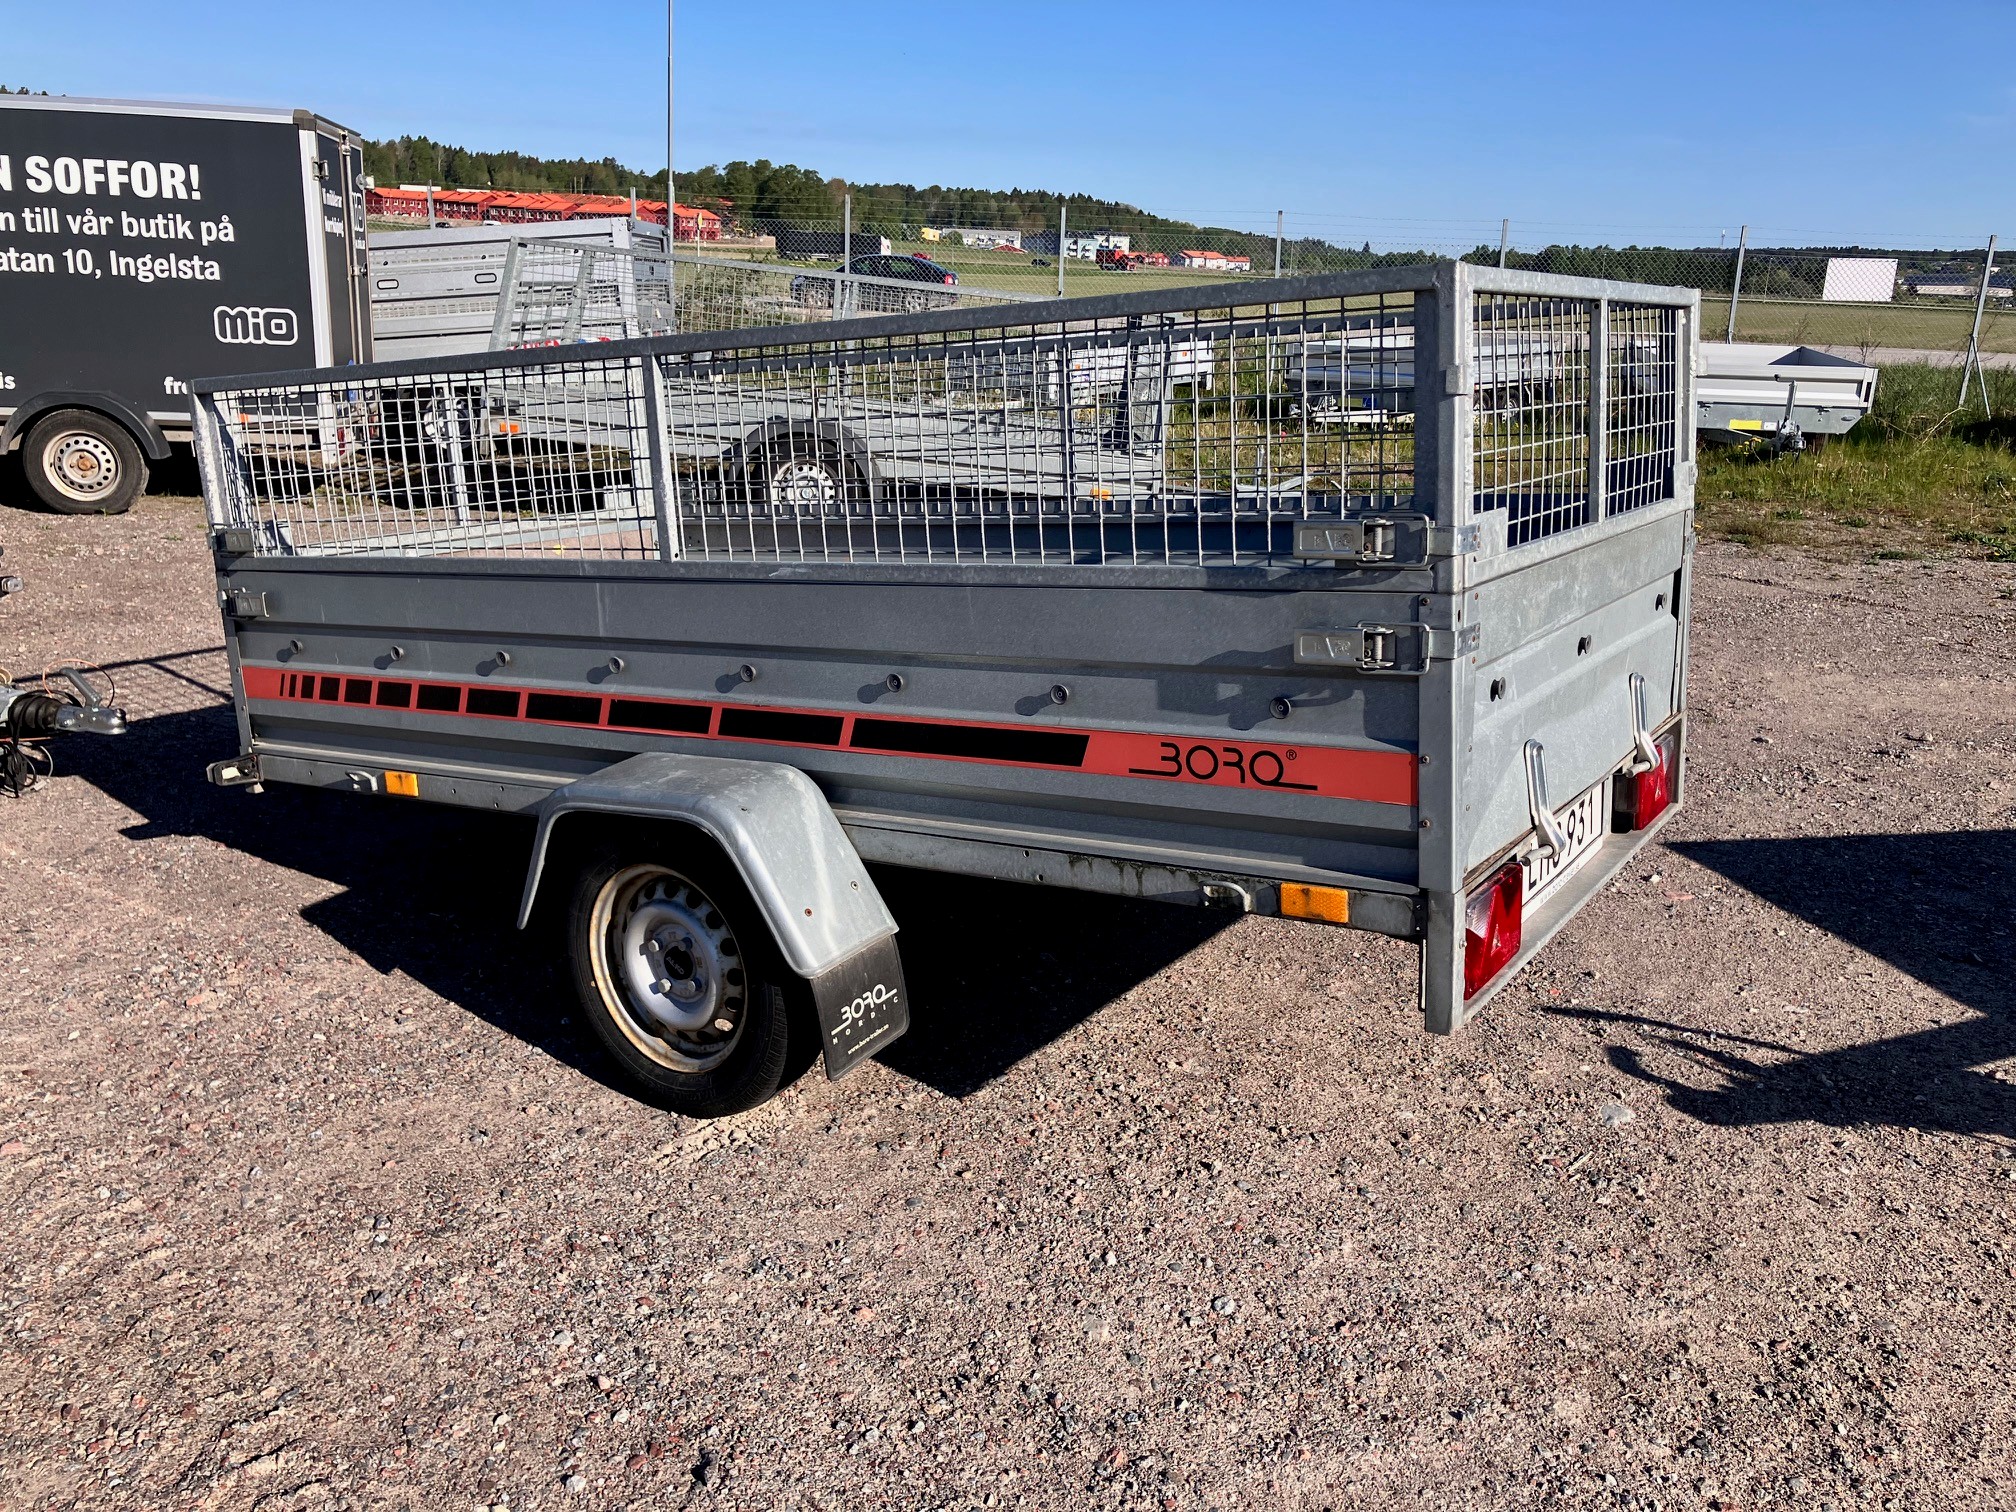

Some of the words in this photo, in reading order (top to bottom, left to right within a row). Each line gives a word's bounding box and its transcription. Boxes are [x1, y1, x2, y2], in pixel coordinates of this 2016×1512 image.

[25, 155, 201, 200] SOFFOR!
[22, 206, 59, 233] till
[66, 207, 114, 236] vår
[121, 210, 194, 240] butik
[200, 214, 235, 246] på
[62, 248, 102, 280] 10,
[109, 250, 221, 283] Ingelsta
[1567, 790, 1594, 857] 931
